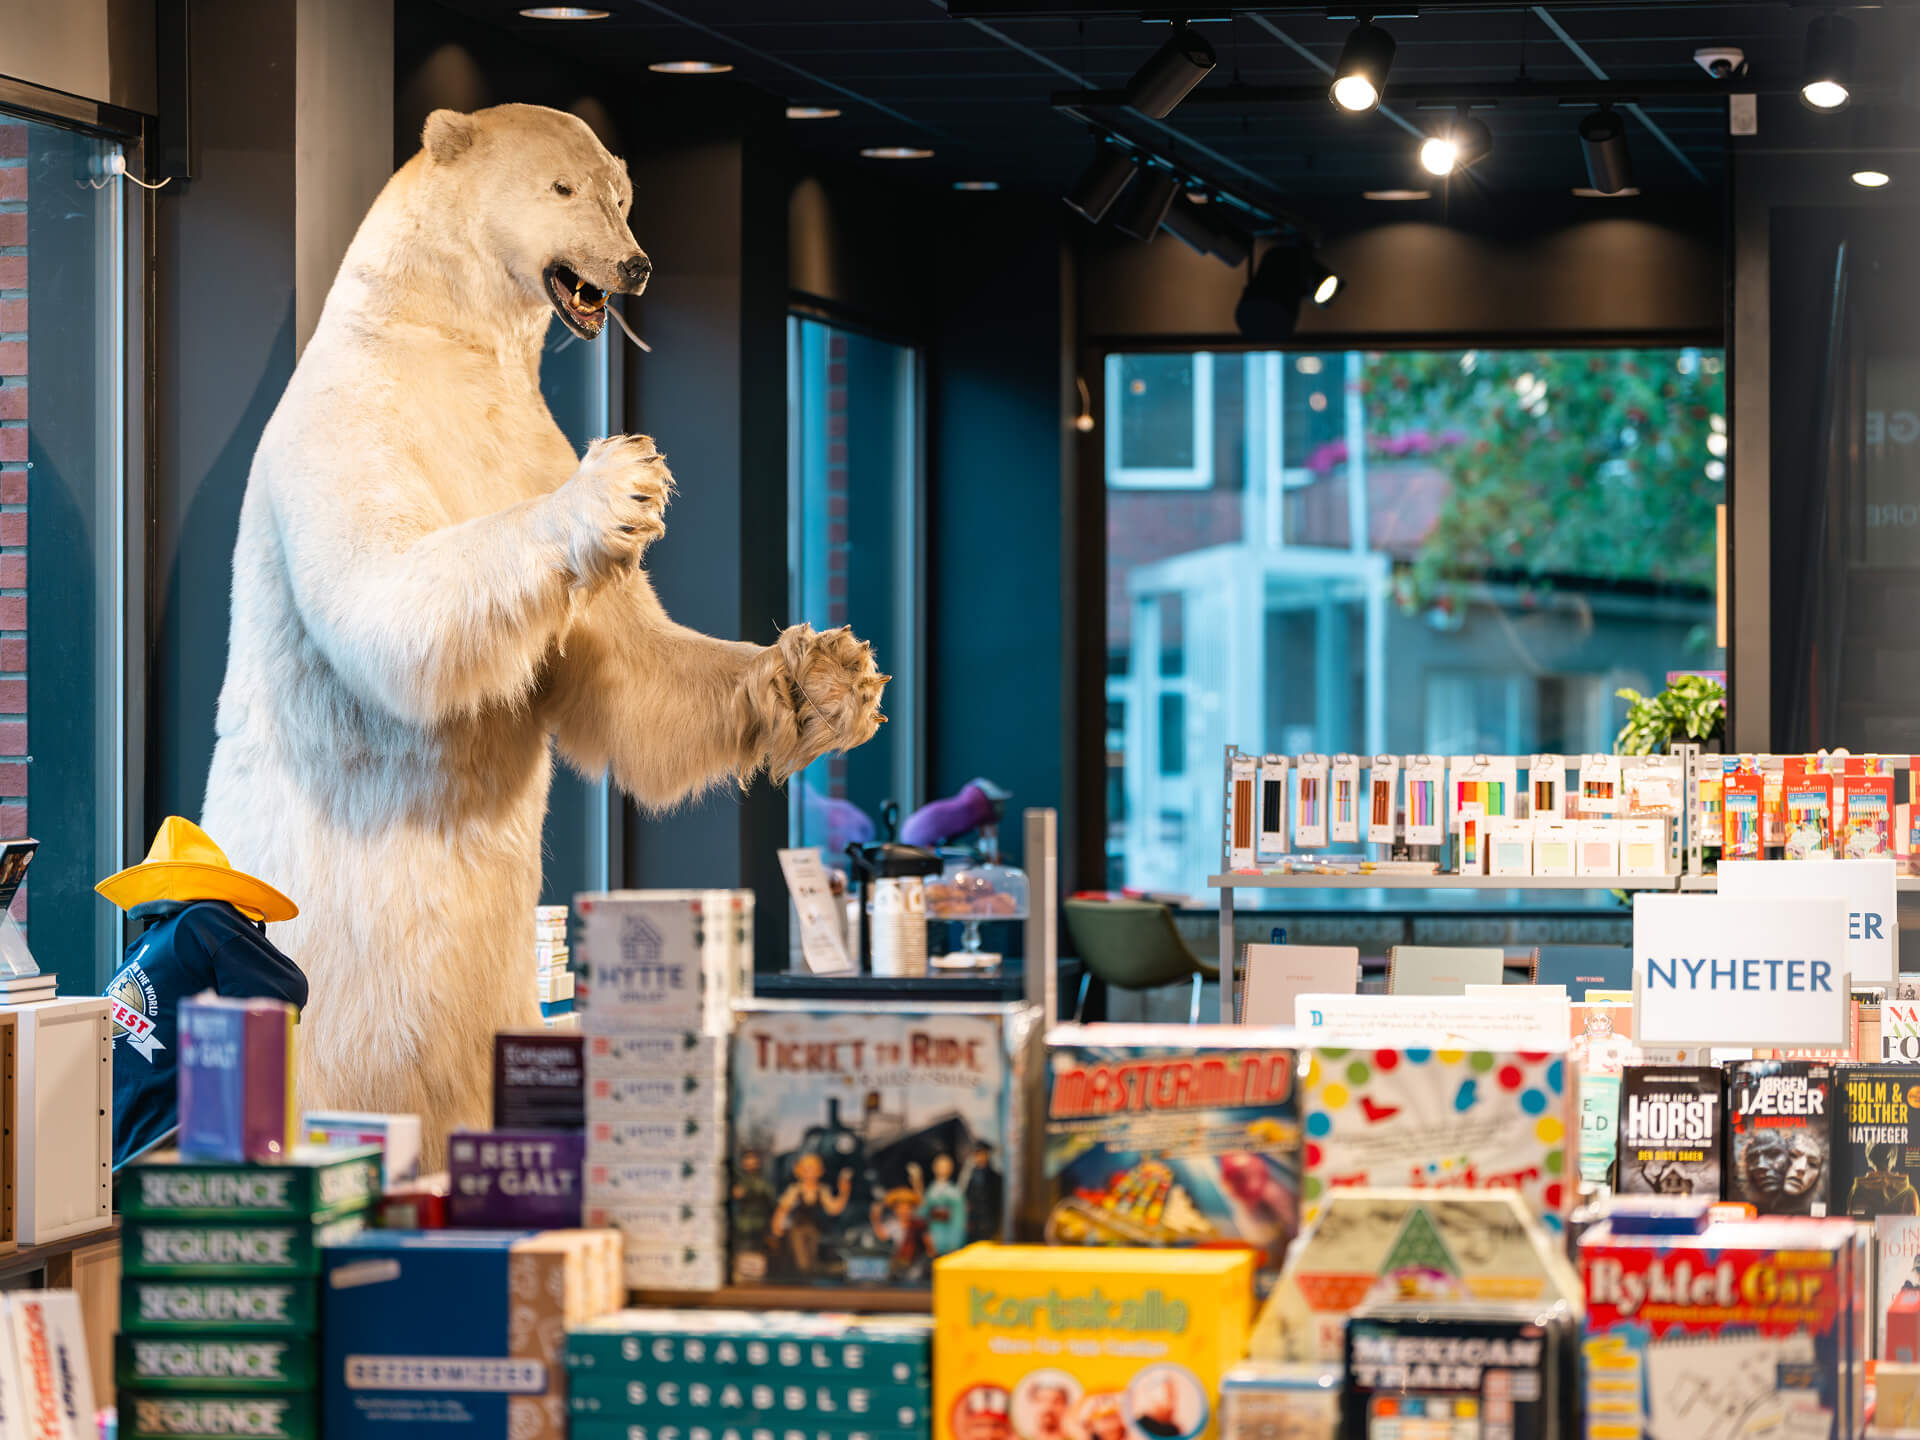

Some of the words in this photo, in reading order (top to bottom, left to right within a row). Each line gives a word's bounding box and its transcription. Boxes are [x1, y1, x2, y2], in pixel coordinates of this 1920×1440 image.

[1849, 912, 1884, 940] ER
[597, 966, 686, 989] HYTTE
[1647, 958, 1833, 992] NYHETER
[137, 970, 149, 987] THE
[144, 984, 158, 1016] WORLD
[754, 1033, 865, 1072] TICKET
[910, 1032, 984, 1072] RIDE
[1049, 1056, 1290, 1117] MASTERMIND
[1760, 1076, 1808, 1093] JØRGEN
[1848, 1082, 1887, 1104] HOLM
[1892, 1083, 1902, 1103] &
[1628, 1093, 1718, 1140] HORST
[1738, 1088, 1824, 1115] JÆGER
[1849, 1103, 1908, 1124] BOLTHER
[1849, 1126, 1908, 1144] NATTJEGER
[480, 1143, 554, 1169] RETT
[141, 1172, 293, 1209] SEQUENCE
[459, 1174, 489, 1195] er
[498, 1169, 575, 1196] GALT
[141, 1228, 295, 1266] SEQUENCE
[139, 1285, 292, 1323] SEQUENCE
[134, 1341, 287, 1379] SEQUENCE
[621, 1337, 864, 1369] SCRABBLE
[1353, 1336, 1543, 1366] MEXICAN
[353, 1362, 535, 1384] BEZZERWIZZER
[1353, 1364, 1482, 1388] TRAIN
[627, 1380, 870, 1413] SCRABBLE
[134, 1400, 288, 1438] SEQUENCE
